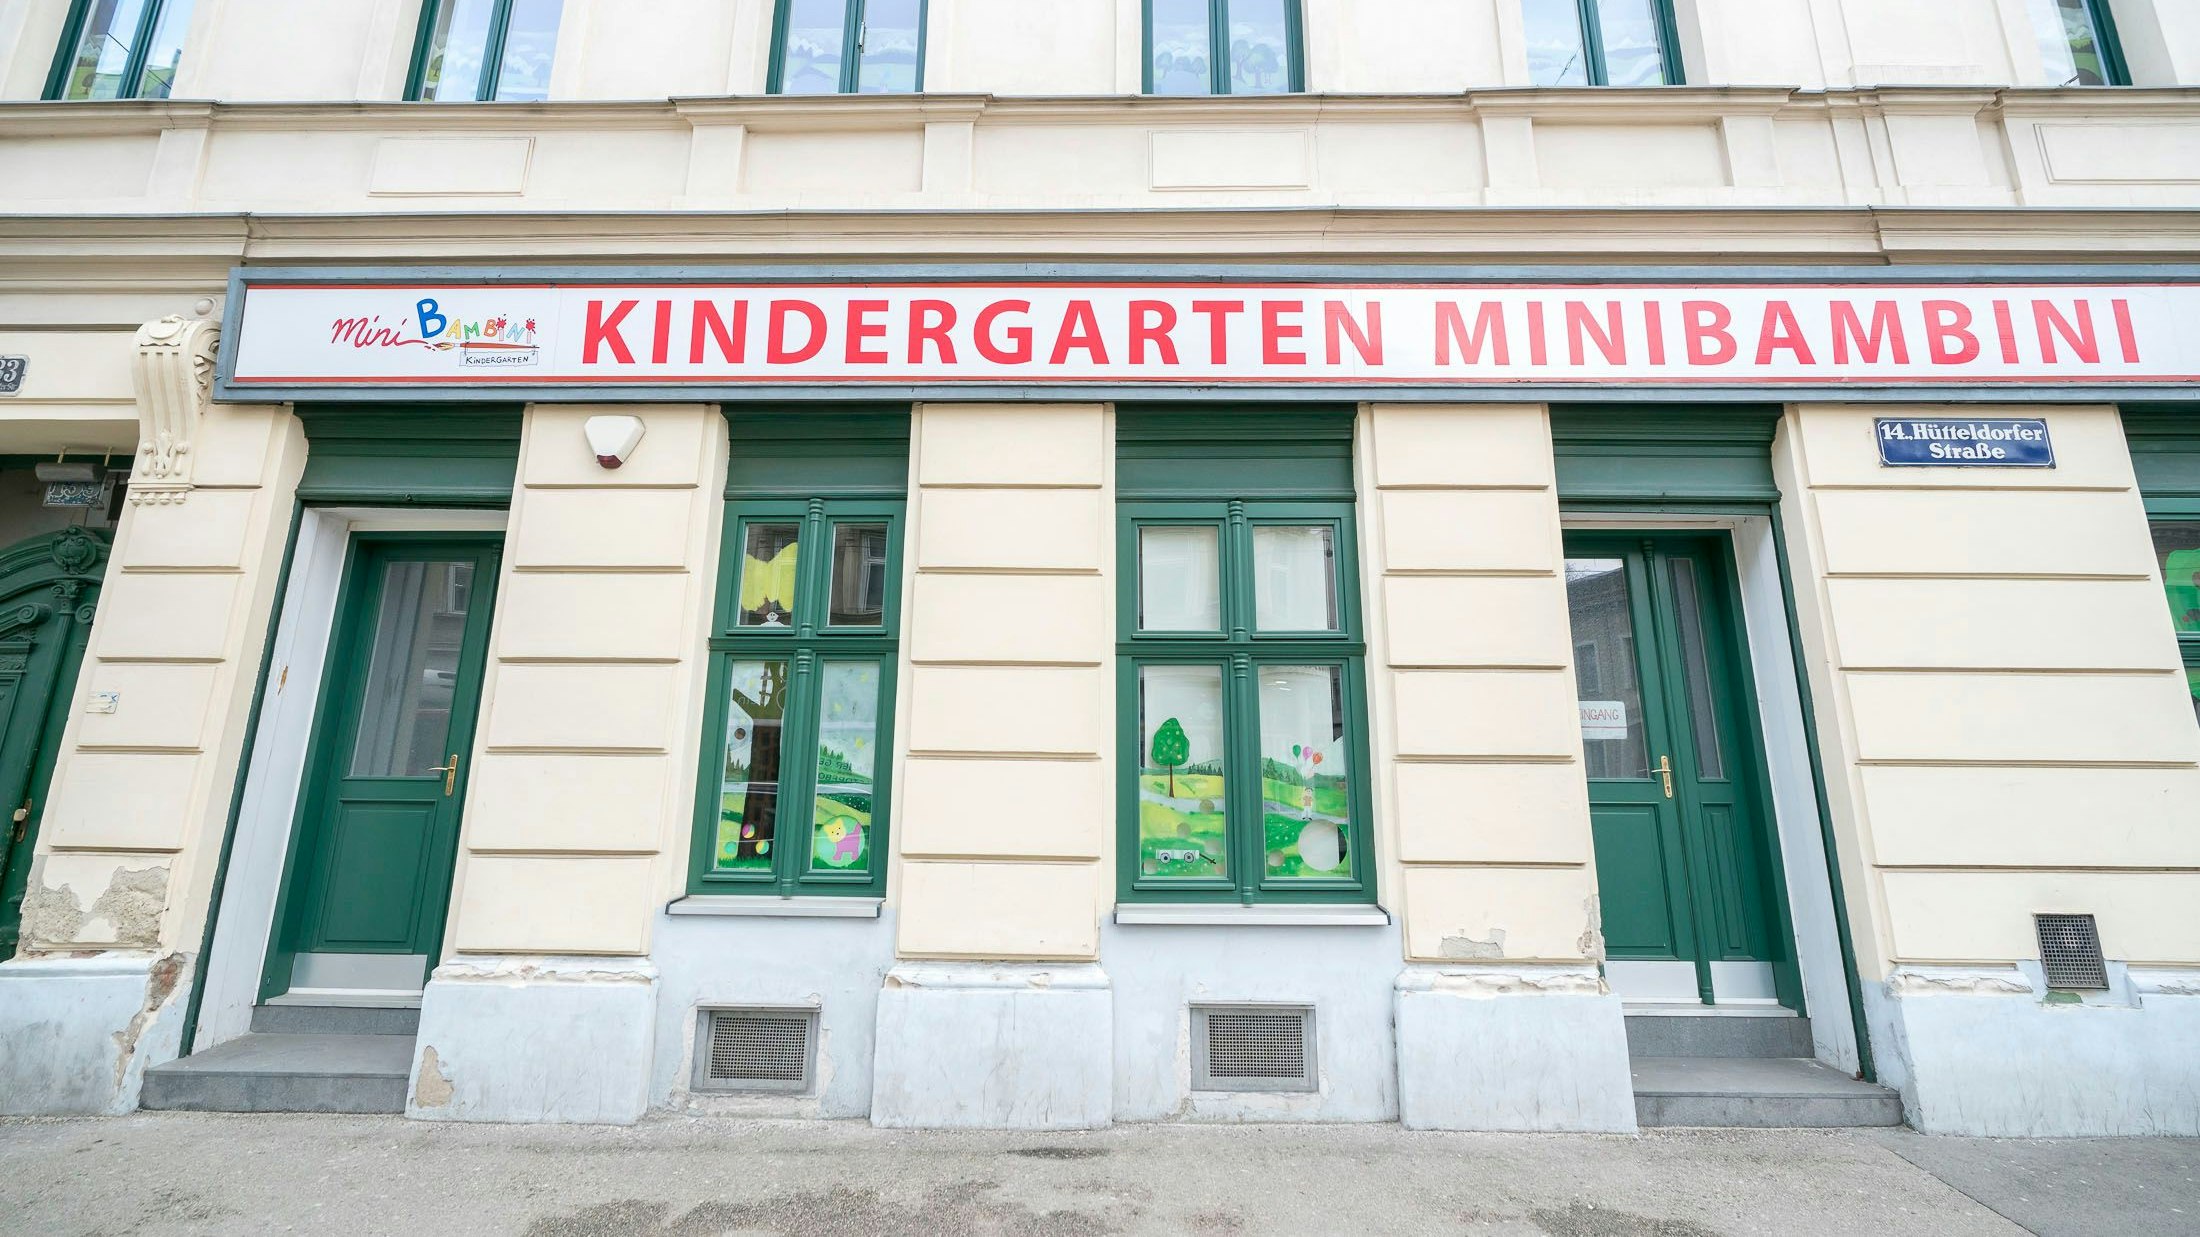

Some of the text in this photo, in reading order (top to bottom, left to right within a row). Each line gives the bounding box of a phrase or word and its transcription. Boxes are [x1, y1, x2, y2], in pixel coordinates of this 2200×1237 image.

[582, 299, 2141, 366] KINDERGARTEN MINIBAMBINI
[1911, 423, 2043, 440] Hütteldorfer
[1929, 442, 2006, 459] Straße
[1579, 708, 1620, 721] INGANG
